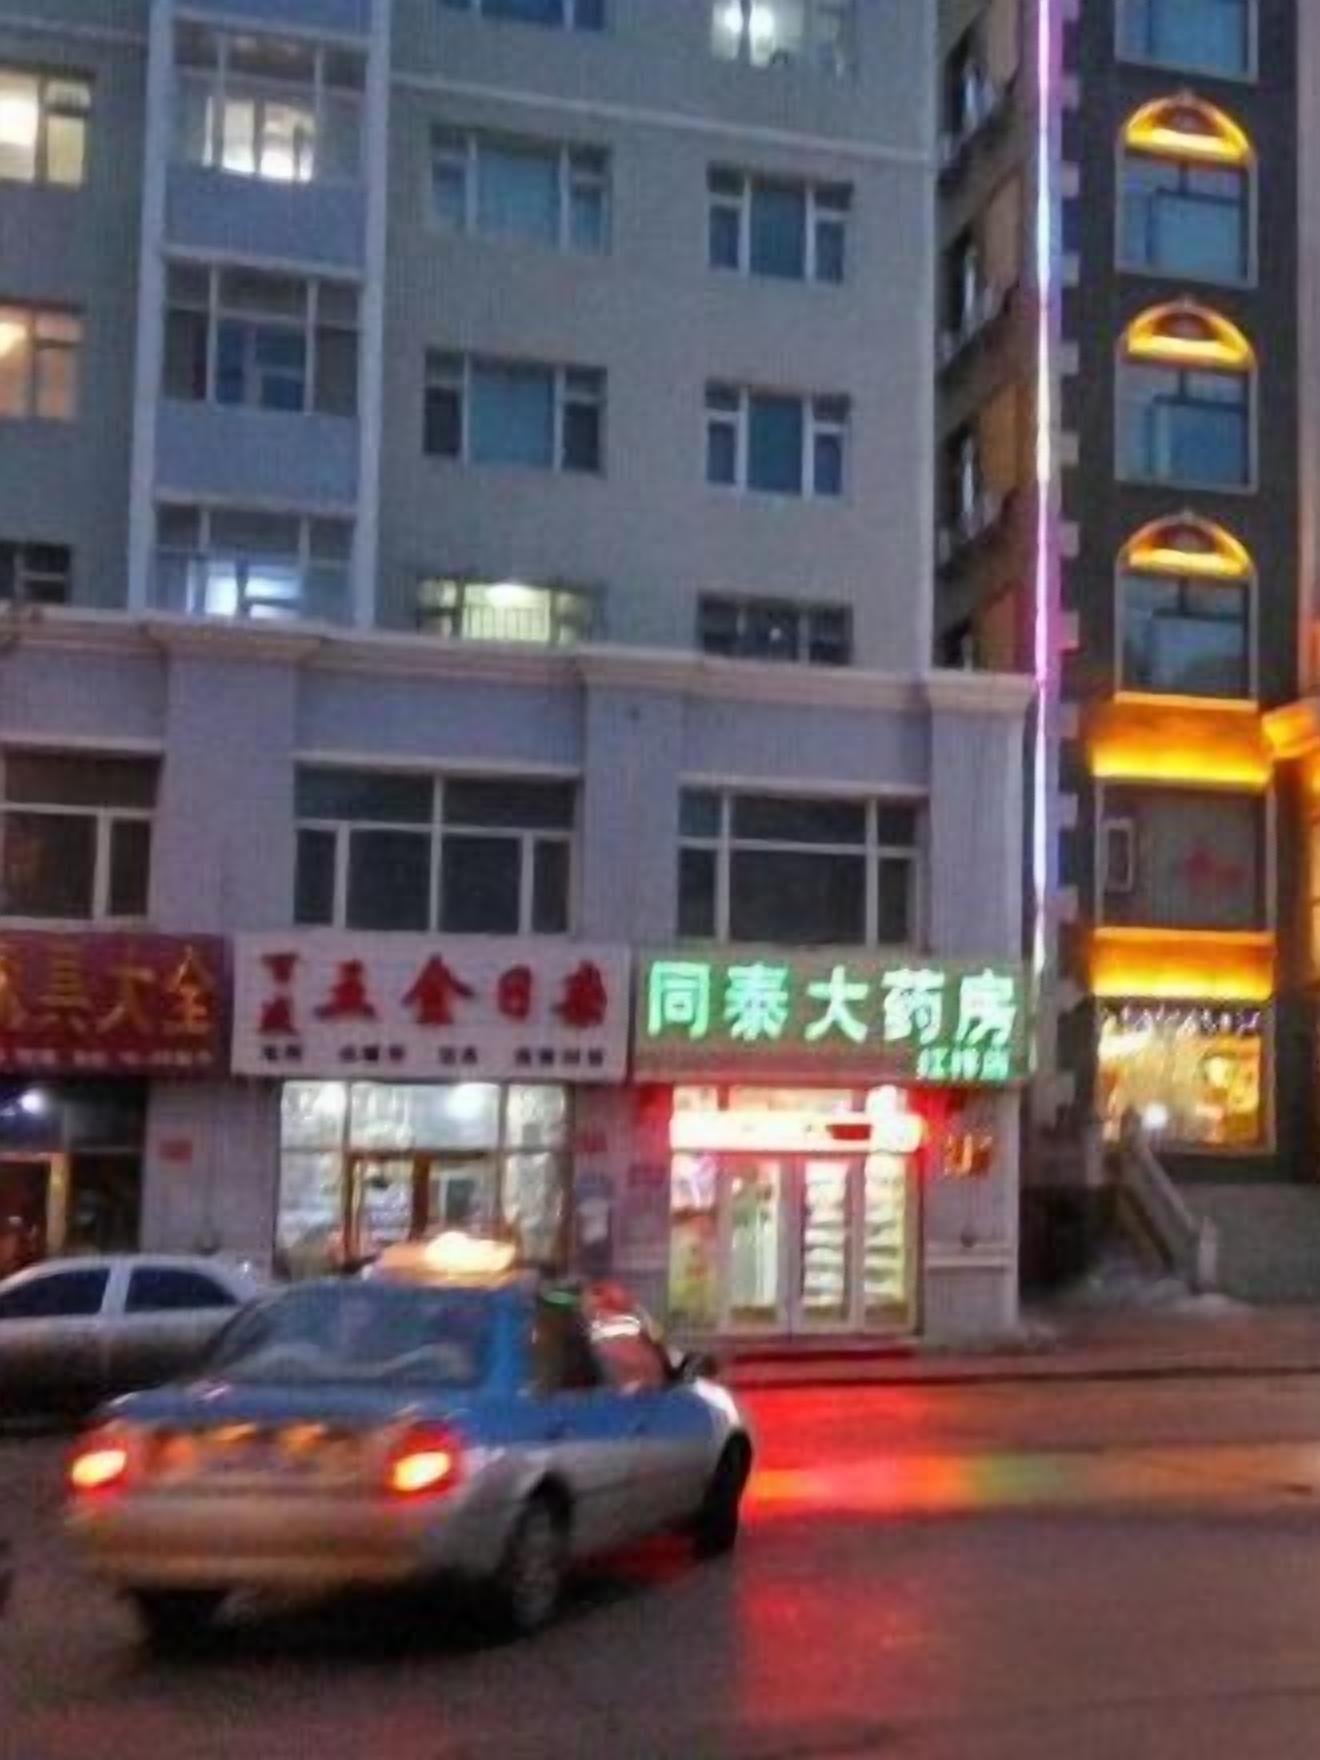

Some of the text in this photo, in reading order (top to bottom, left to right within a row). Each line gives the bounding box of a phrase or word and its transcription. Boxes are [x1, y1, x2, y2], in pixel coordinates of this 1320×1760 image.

[648, 960, 1018, 1043] 同泰大药房
